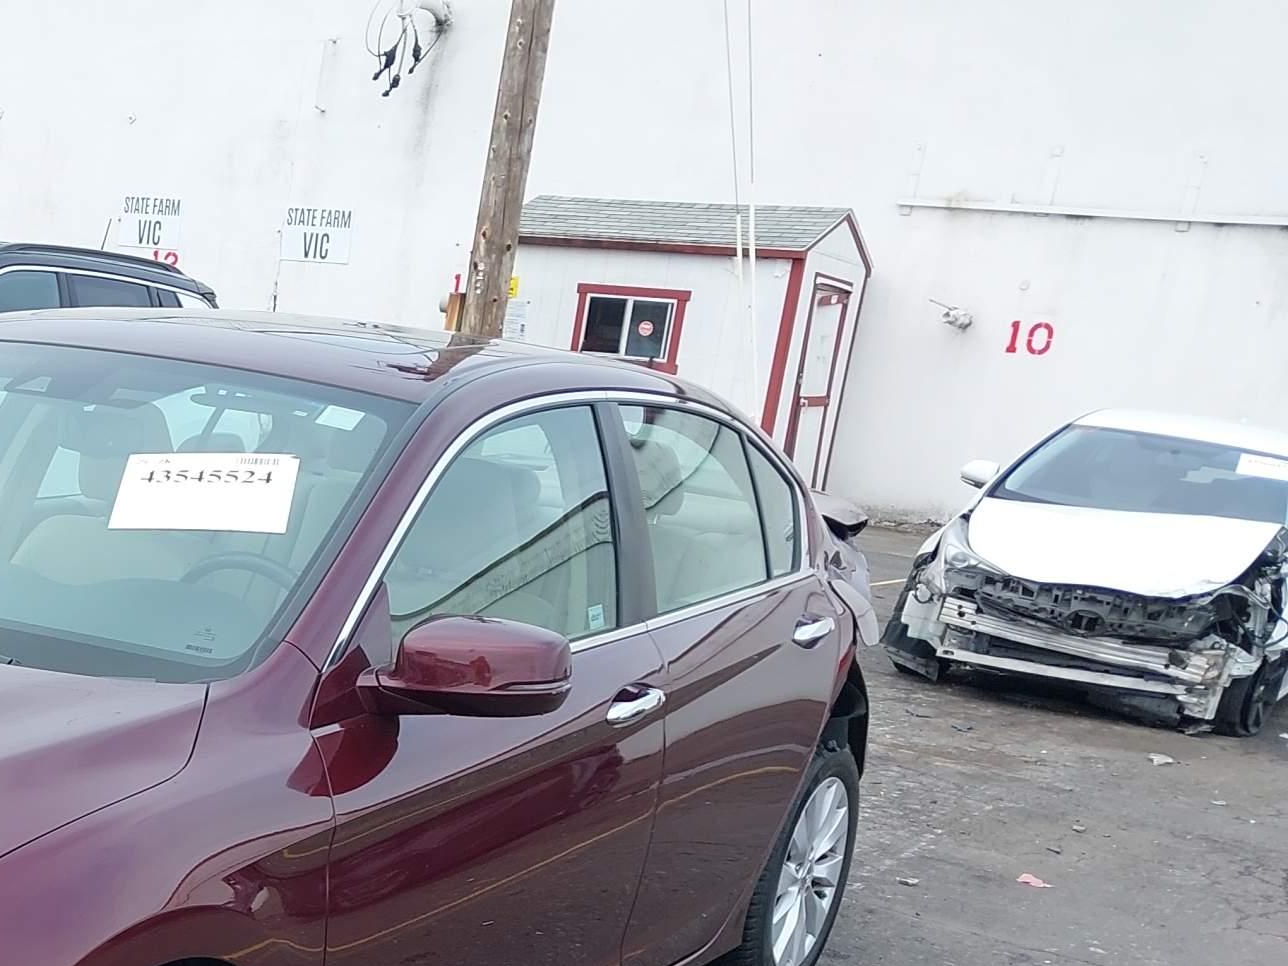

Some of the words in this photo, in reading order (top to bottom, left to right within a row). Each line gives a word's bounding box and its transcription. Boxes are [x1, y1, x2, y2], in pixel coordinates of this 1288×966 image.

[124, 196, 150, 215] STATE
[152, 198, 181, 217] FARM
[287, 207, 318, 227] STATE
[319, 209, 352, 229] FARM
[137, 219, 162, 246] VIC
[303, 232, 330, 260] VIC
[1005, 320, 1054, 356] 10
[140, 470, 273, 484] 43545524
